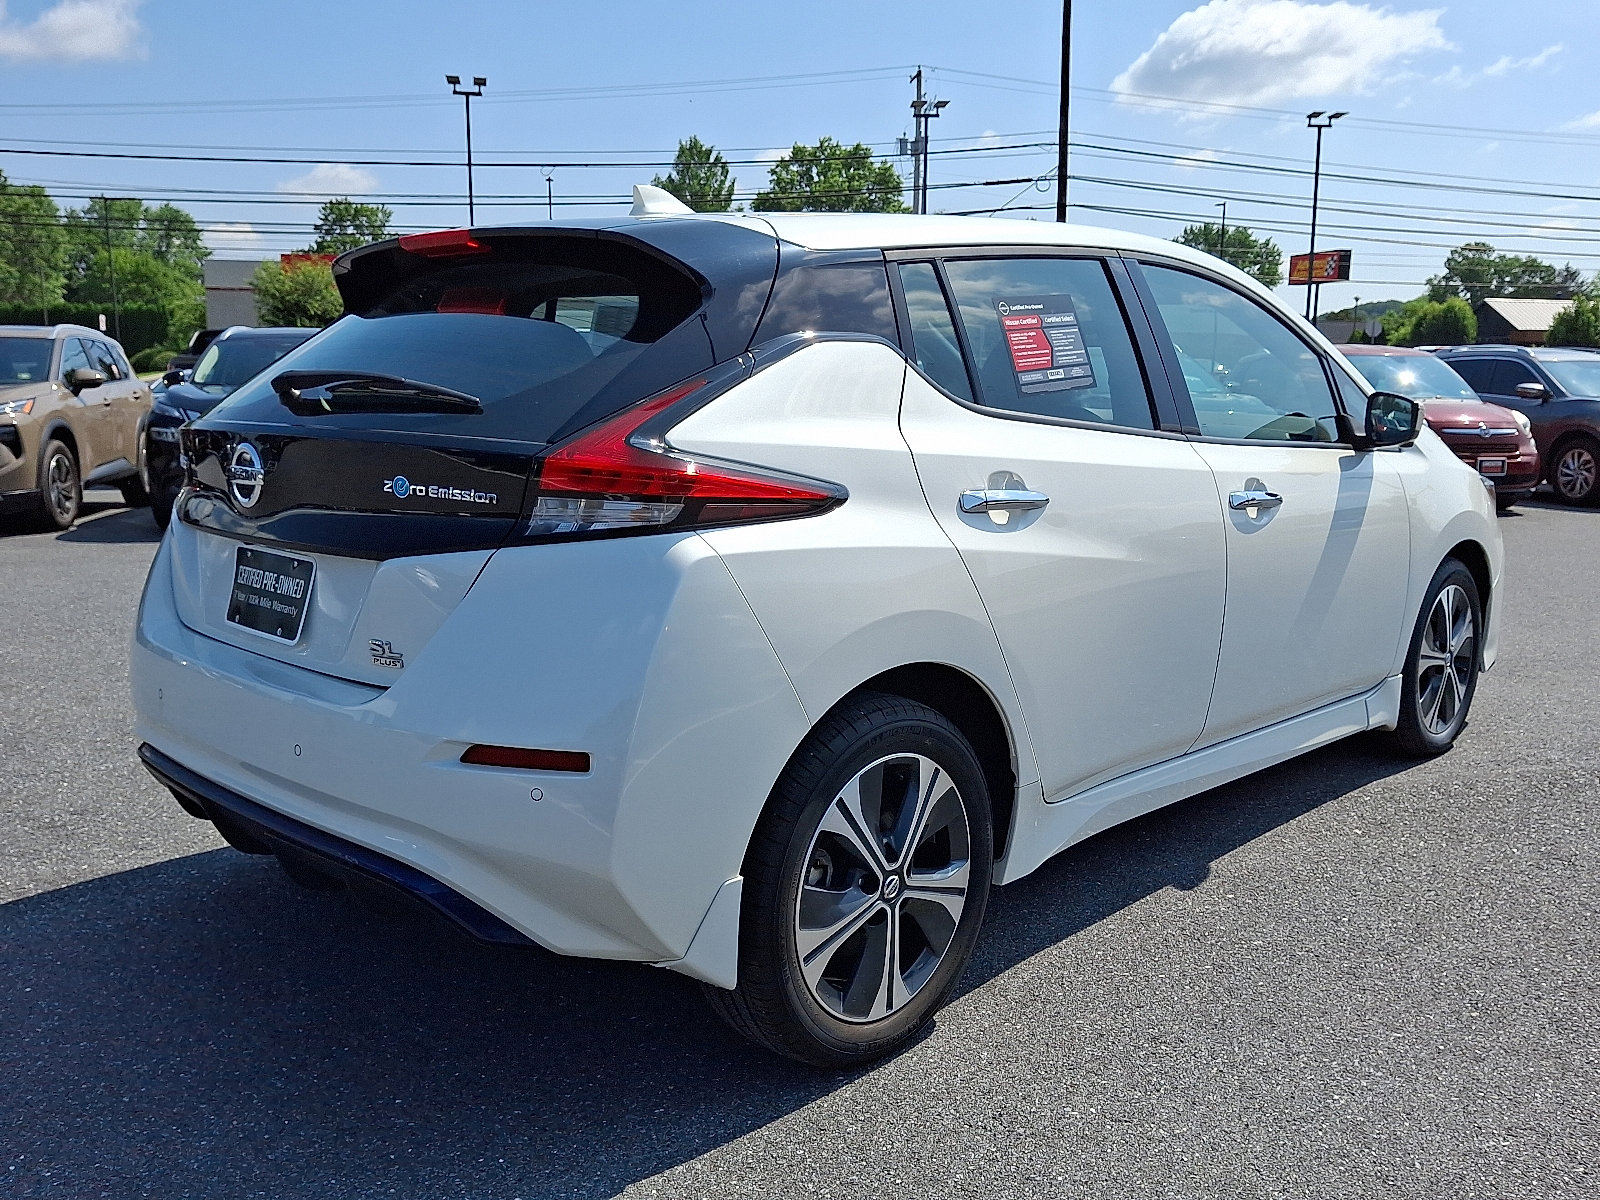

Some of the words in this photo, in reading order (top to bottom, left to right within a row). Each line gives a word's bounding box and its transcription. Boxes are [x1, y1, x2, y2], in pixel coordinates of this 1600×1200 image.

[428, 485, 497, 504] Emission
[237, 565, 264, 589] CERTIFIED
[262, 571, 305, 599] PRE-OWNED
[272, 600, 298, 618] Warranty
[368, 638, 404, 659] SL
[373, 658, 398, 667] PLUS
